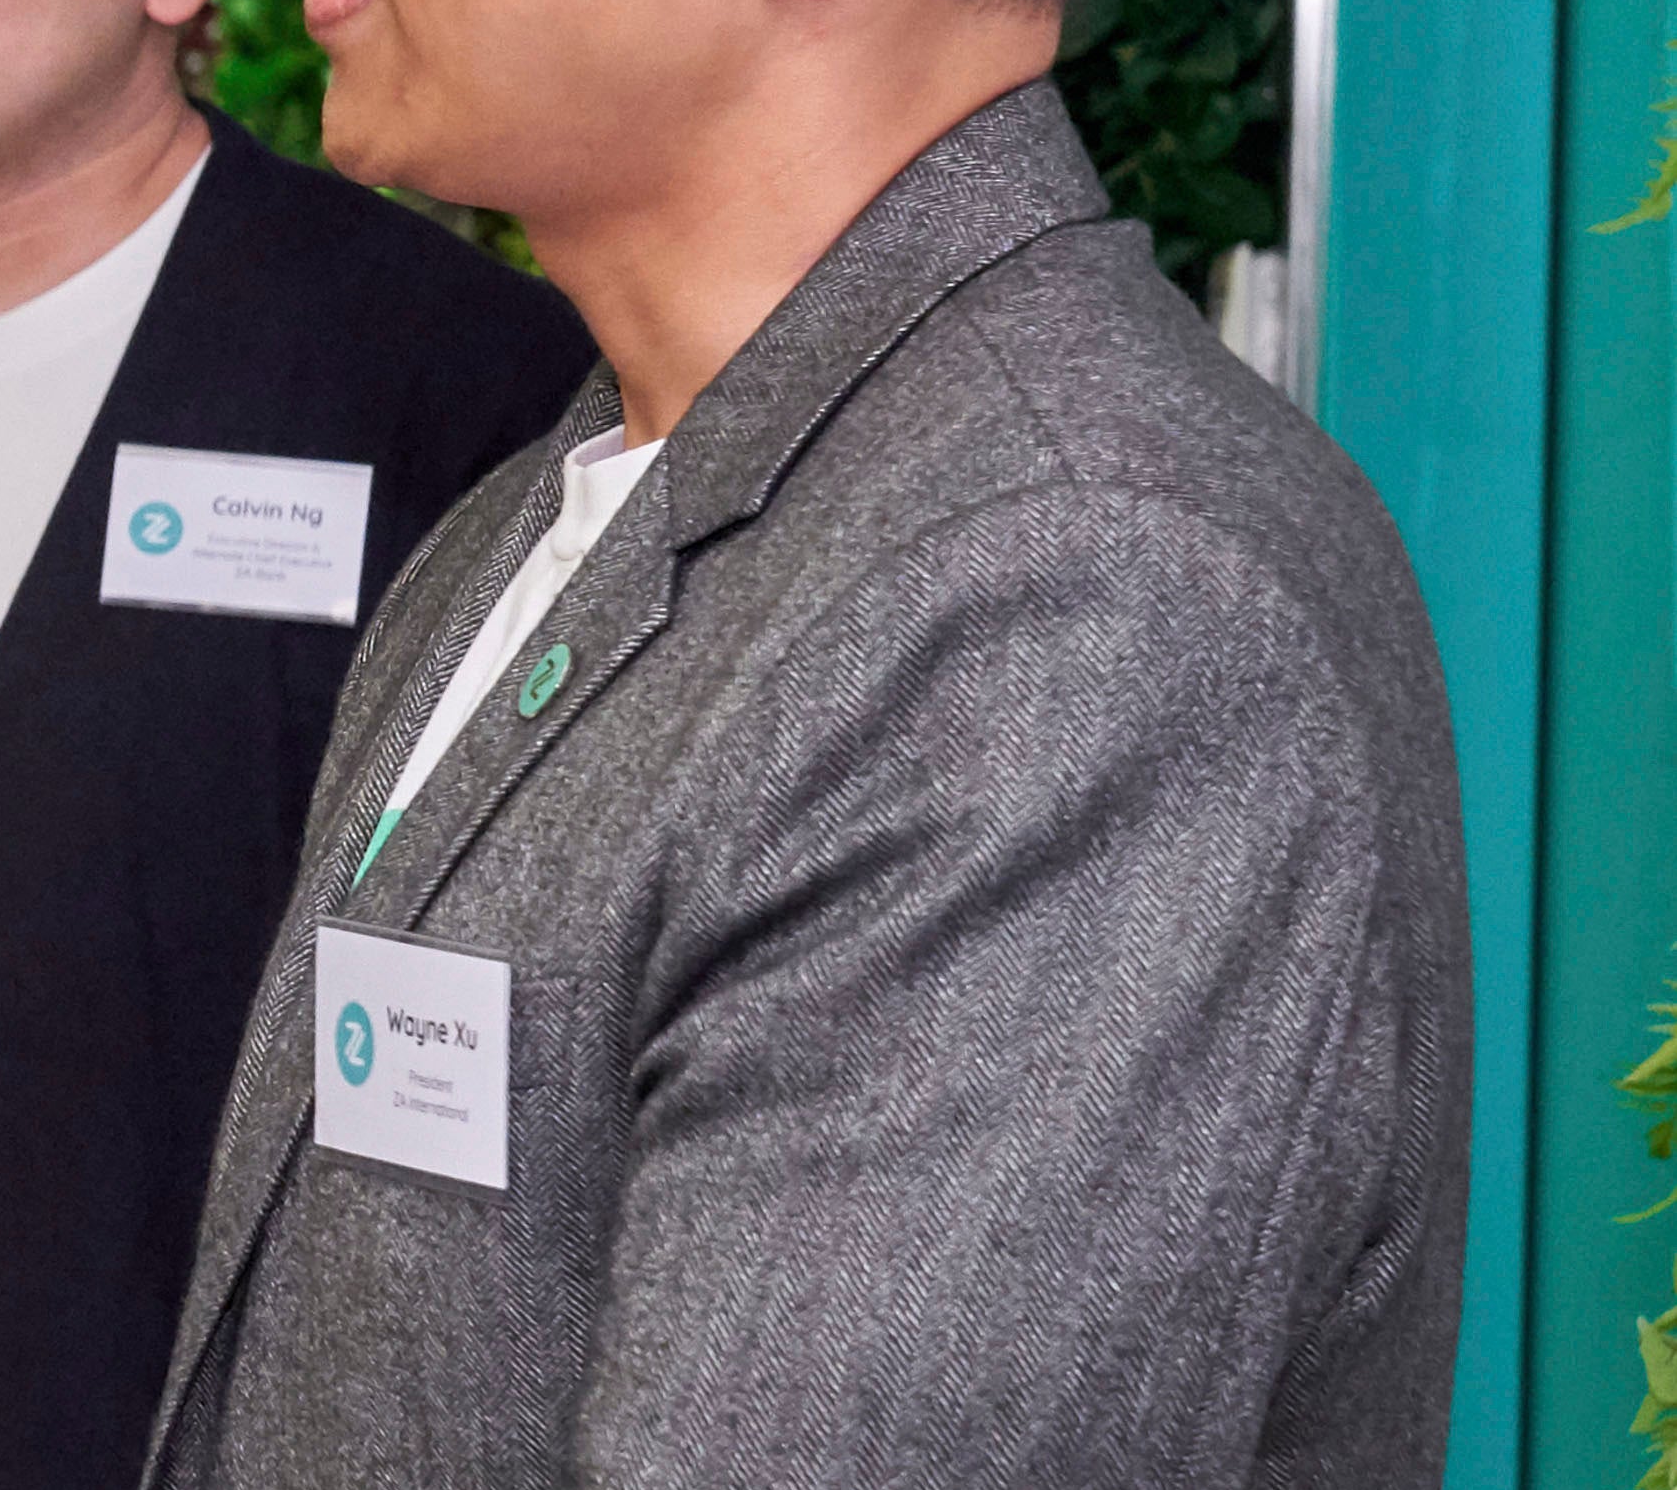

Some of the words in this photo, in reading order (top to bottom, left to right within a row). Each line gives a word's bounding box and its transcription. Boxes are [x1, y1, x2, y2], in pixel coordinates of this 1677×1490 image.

[212, 495, 283, 520] Calvin
[291, 501, 323, 528] Ng
[386, 1005, 449, 1046] Wayne
[453, 1019, 479, 1050] Xu
